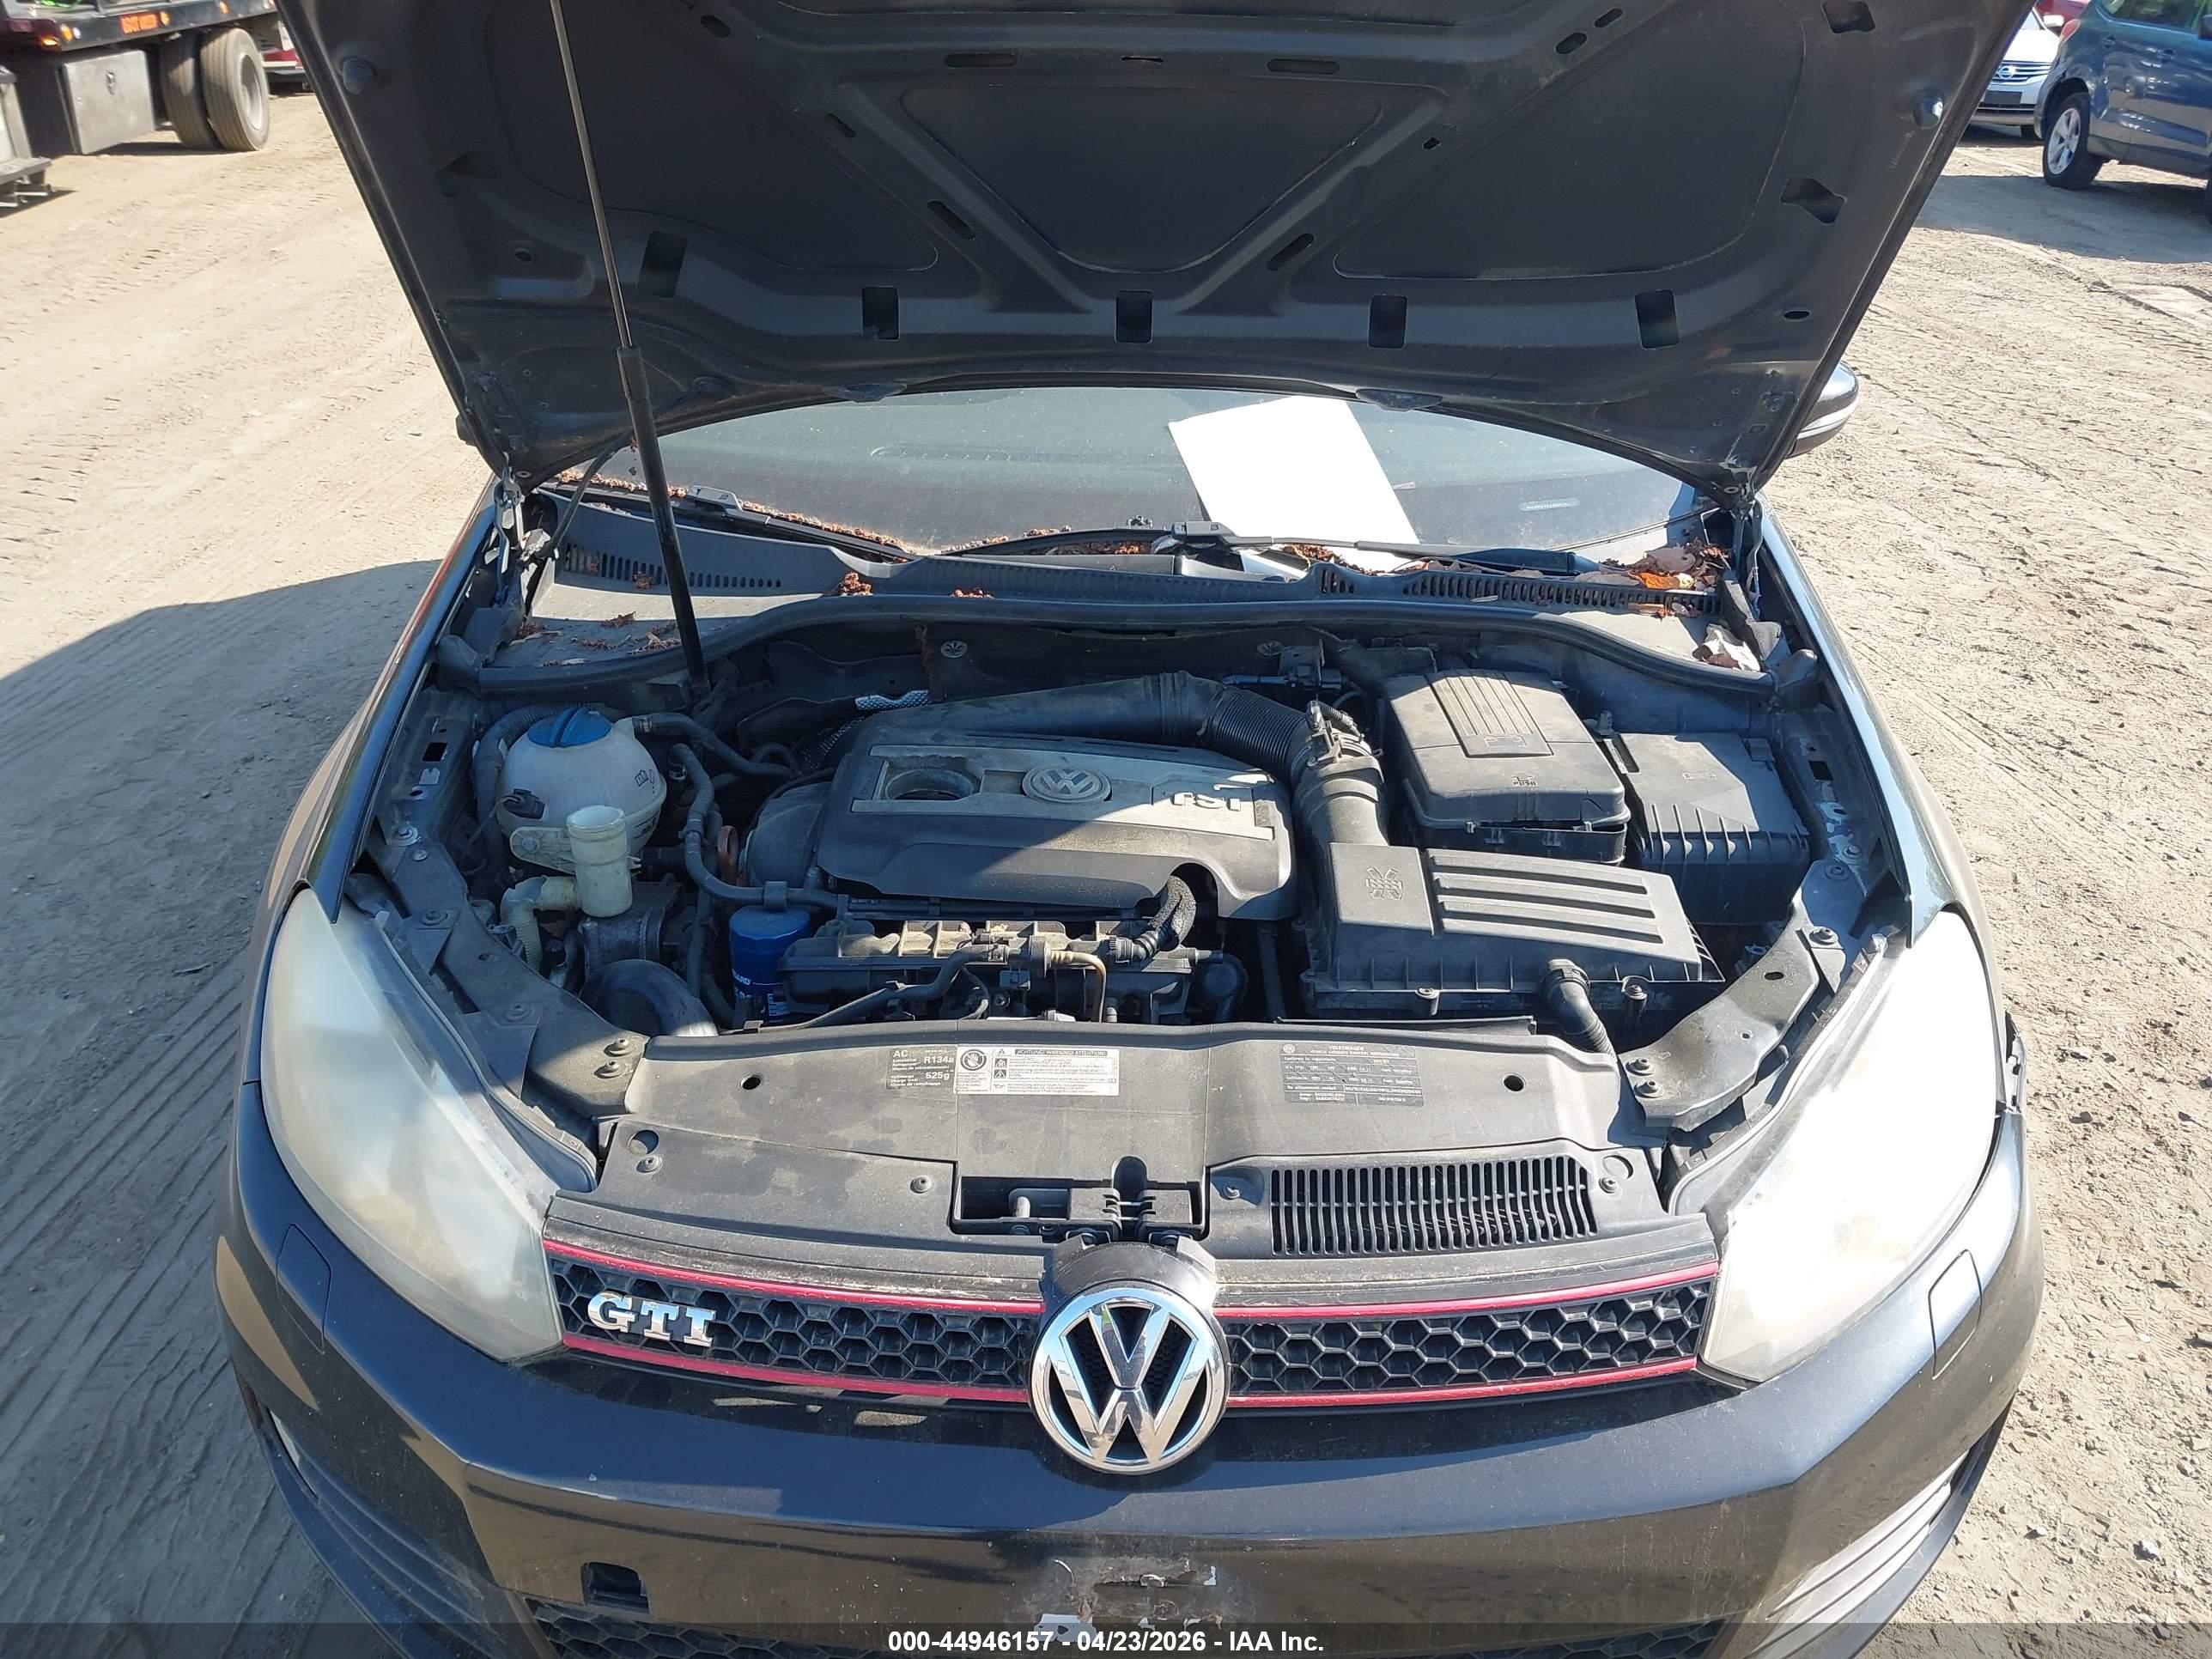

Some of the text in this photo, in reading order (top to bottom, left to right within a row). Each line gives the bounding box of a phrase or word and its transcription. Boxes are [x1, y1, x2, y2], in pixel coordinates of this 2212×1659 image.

[893, 1049, 908, 1058] AC
[923, 1055, 955, 1064] R134a
[925, 1071, 951, 1080] 525g
[587, 1291, 716, 1347] GTI
